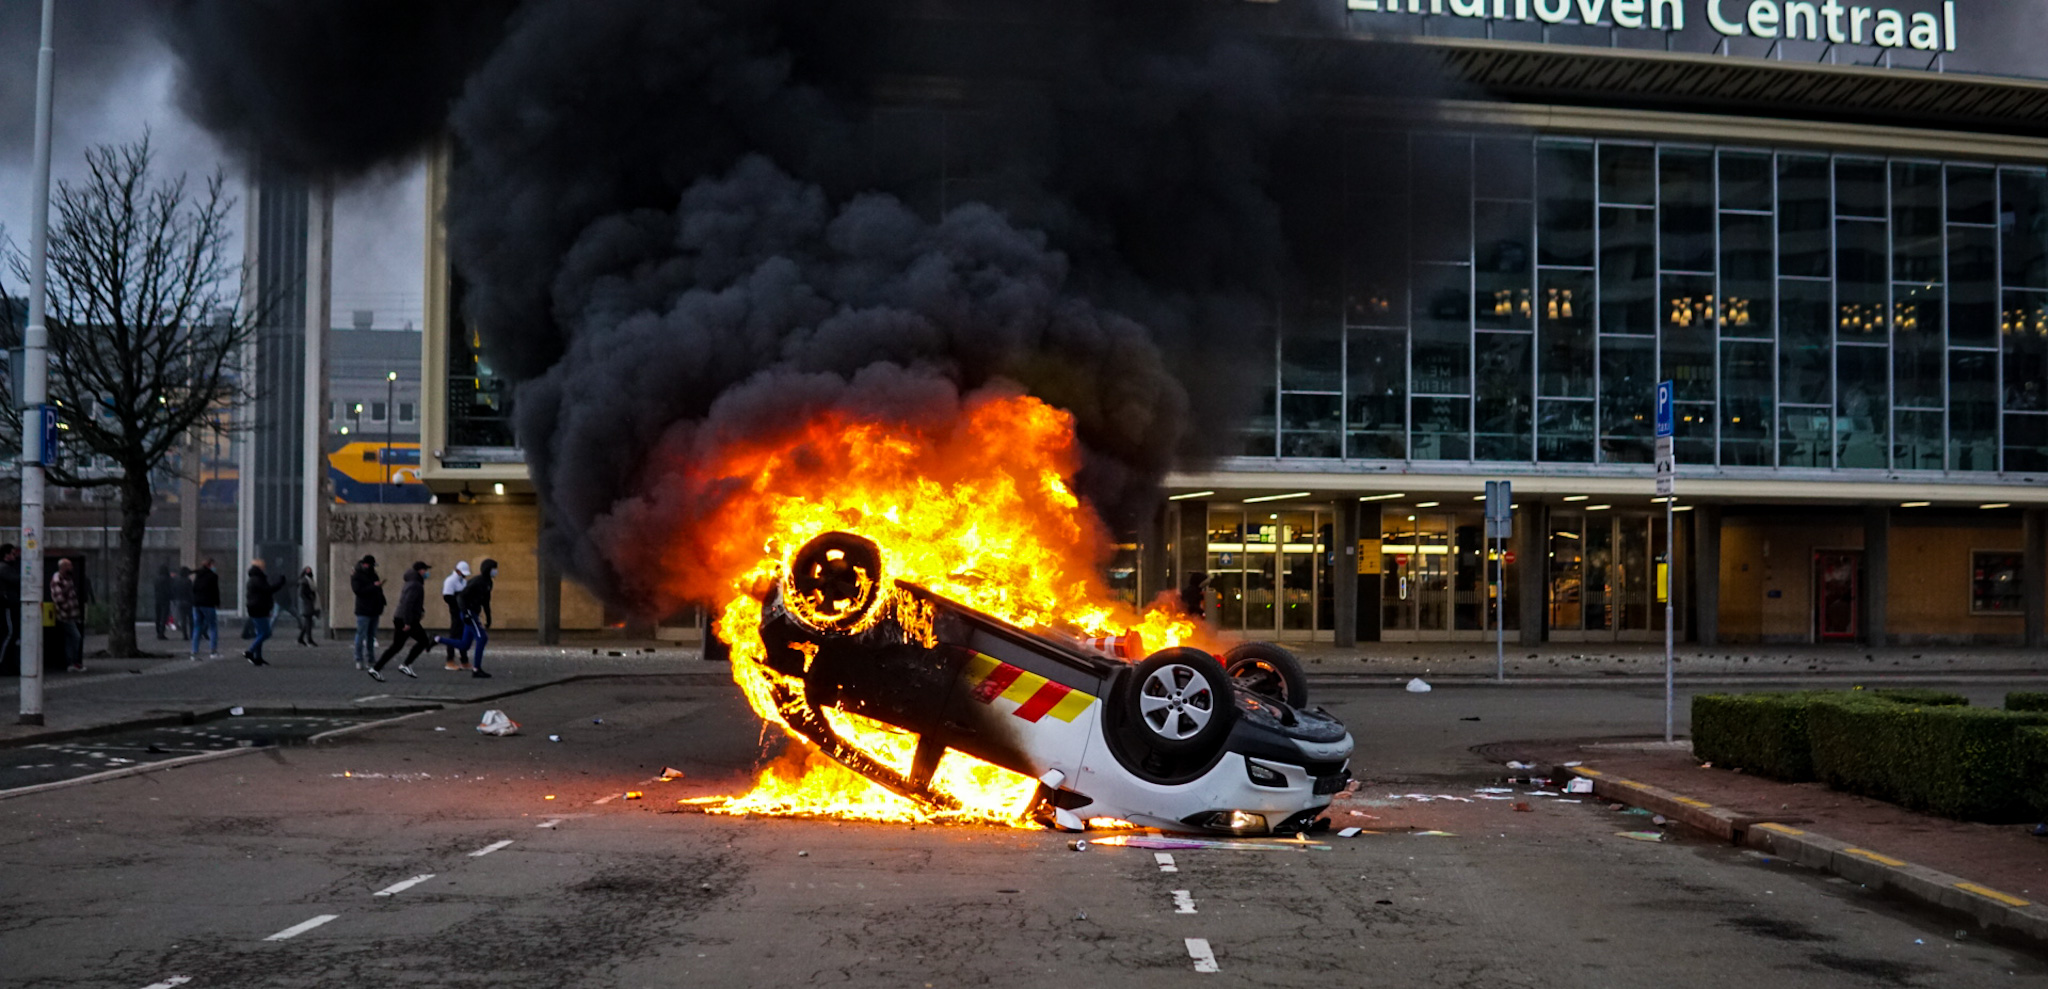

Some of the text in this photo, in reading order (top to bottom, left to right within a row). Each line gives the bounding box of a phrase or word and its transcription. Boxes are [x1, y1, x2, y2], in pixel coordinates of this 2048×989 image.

[1706, 0, 1956, 51] Centraal
[1660, 387, 1667, 414] P
[47, 411, 55, 440] P
